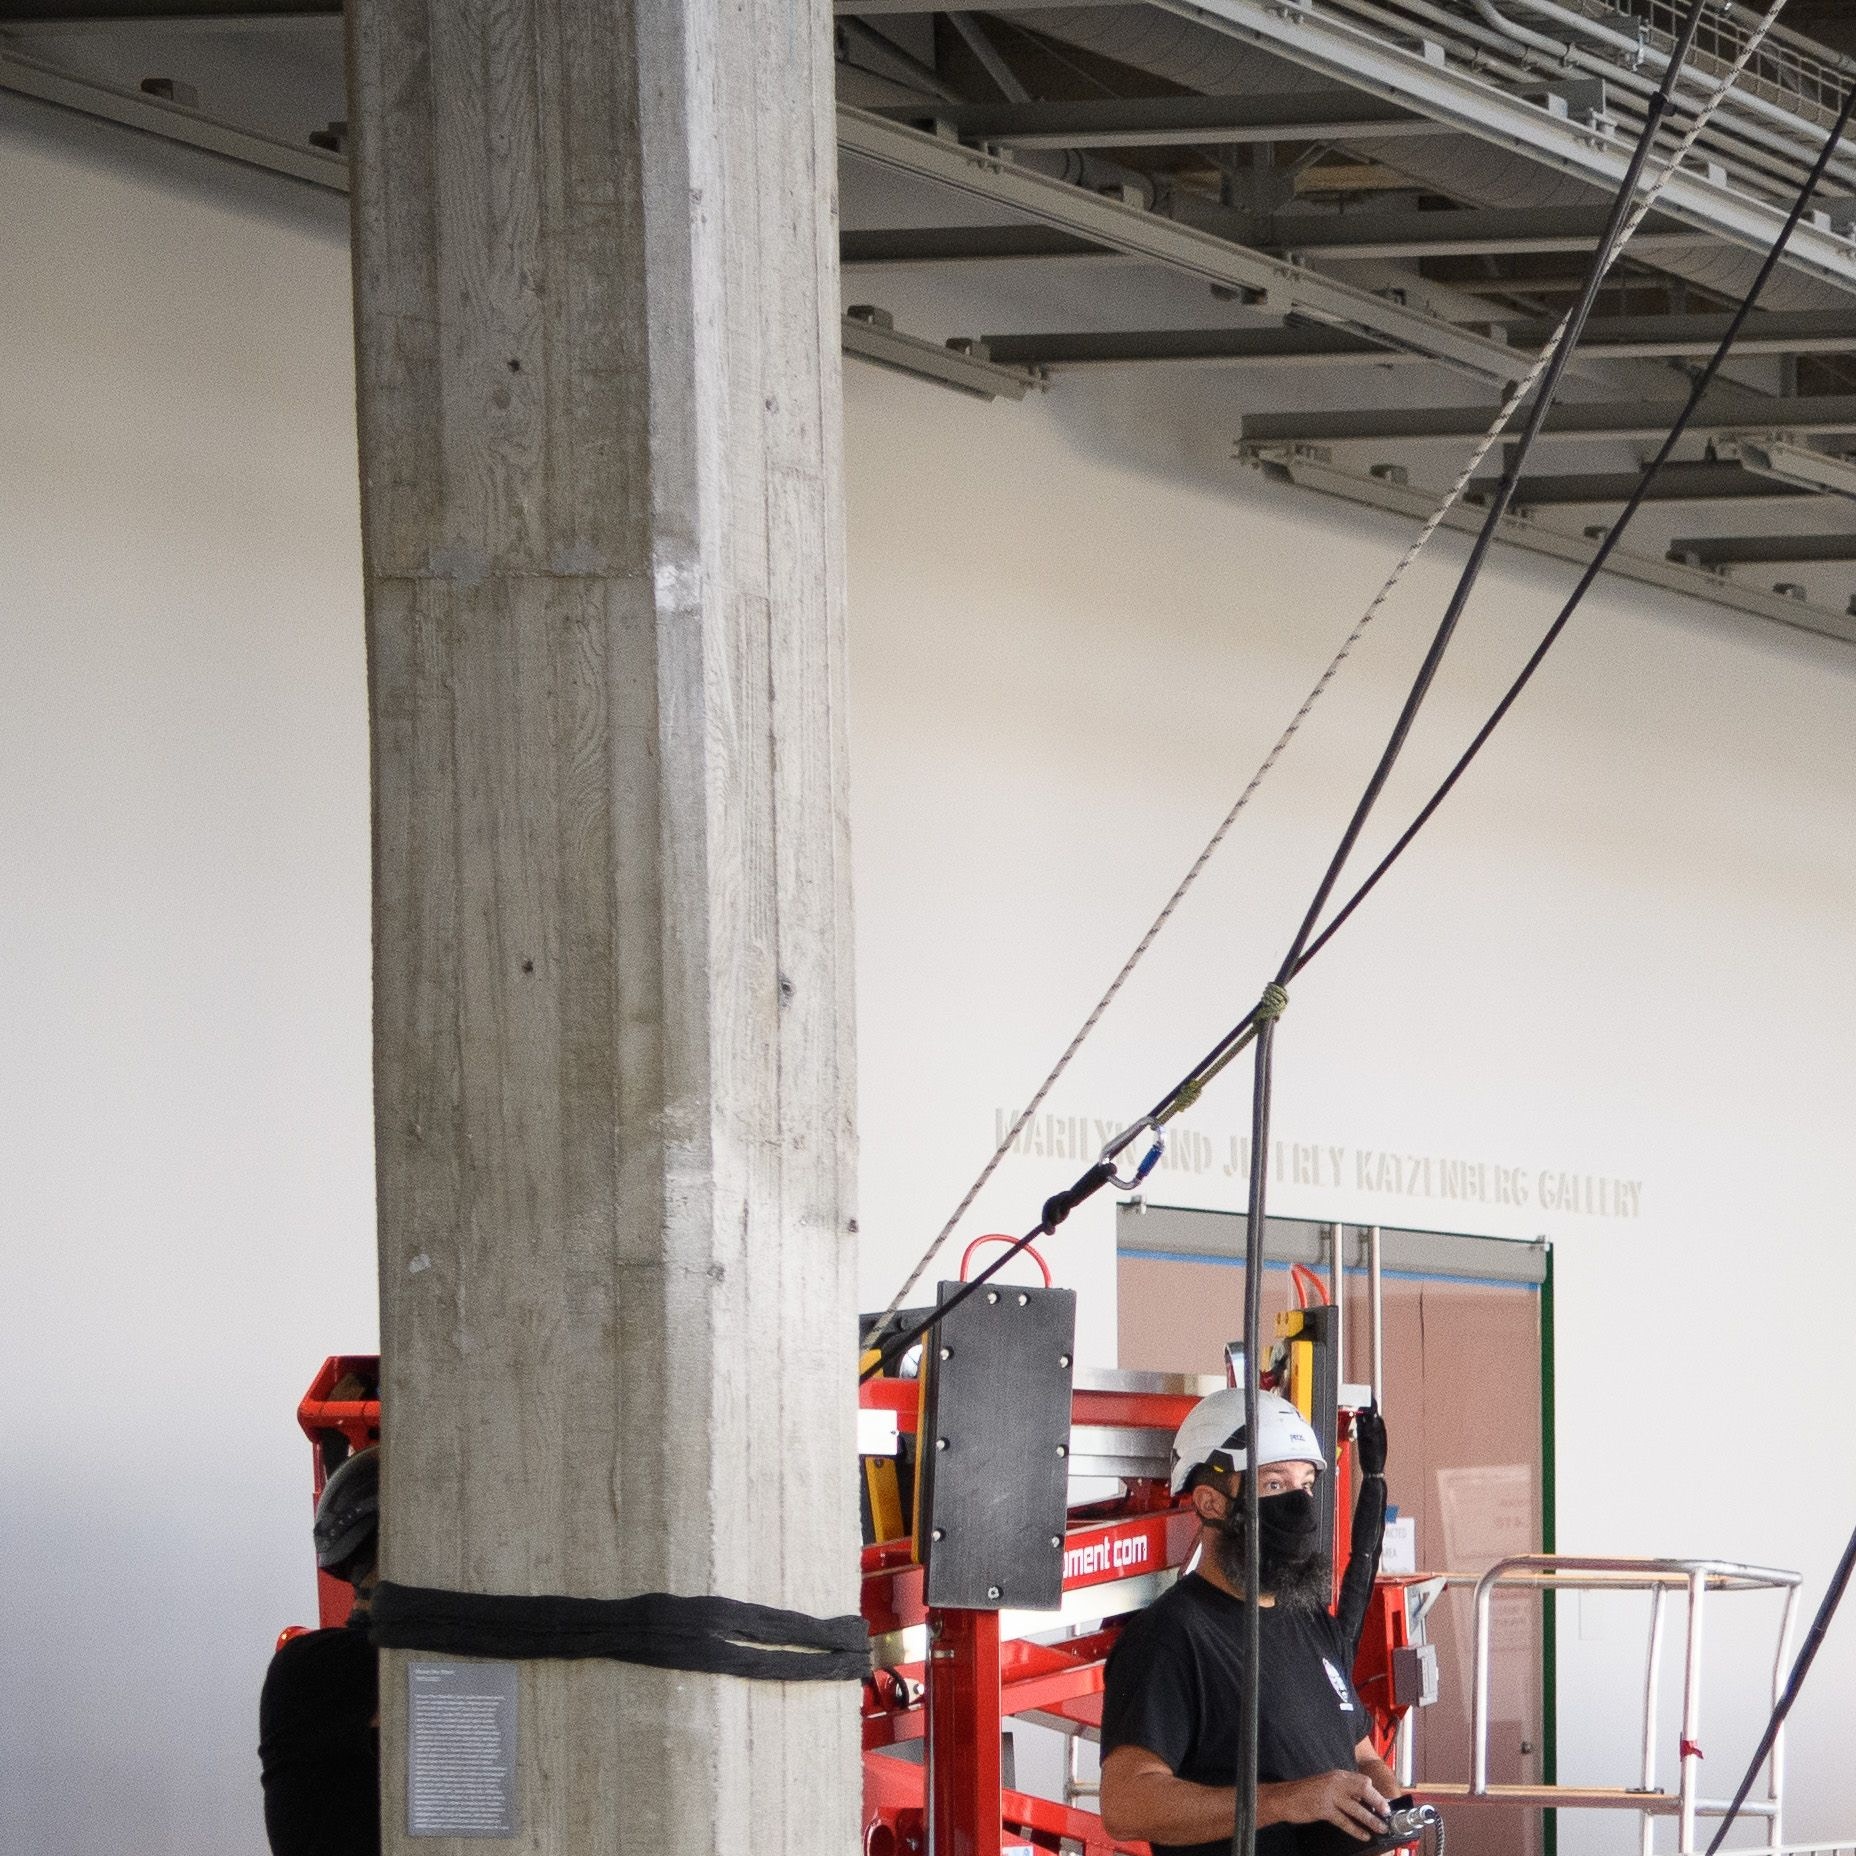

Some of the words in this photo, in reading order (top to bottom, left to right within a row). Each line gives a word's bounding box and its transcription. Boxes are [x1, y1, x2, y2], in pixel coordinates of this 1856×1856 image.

[1222, 1135, 1345, 1188] JEFREY
[1355, 1150, 1529, 1207] KATZENBERG
[1537, 1168, 1643, 1218] GALLERY
